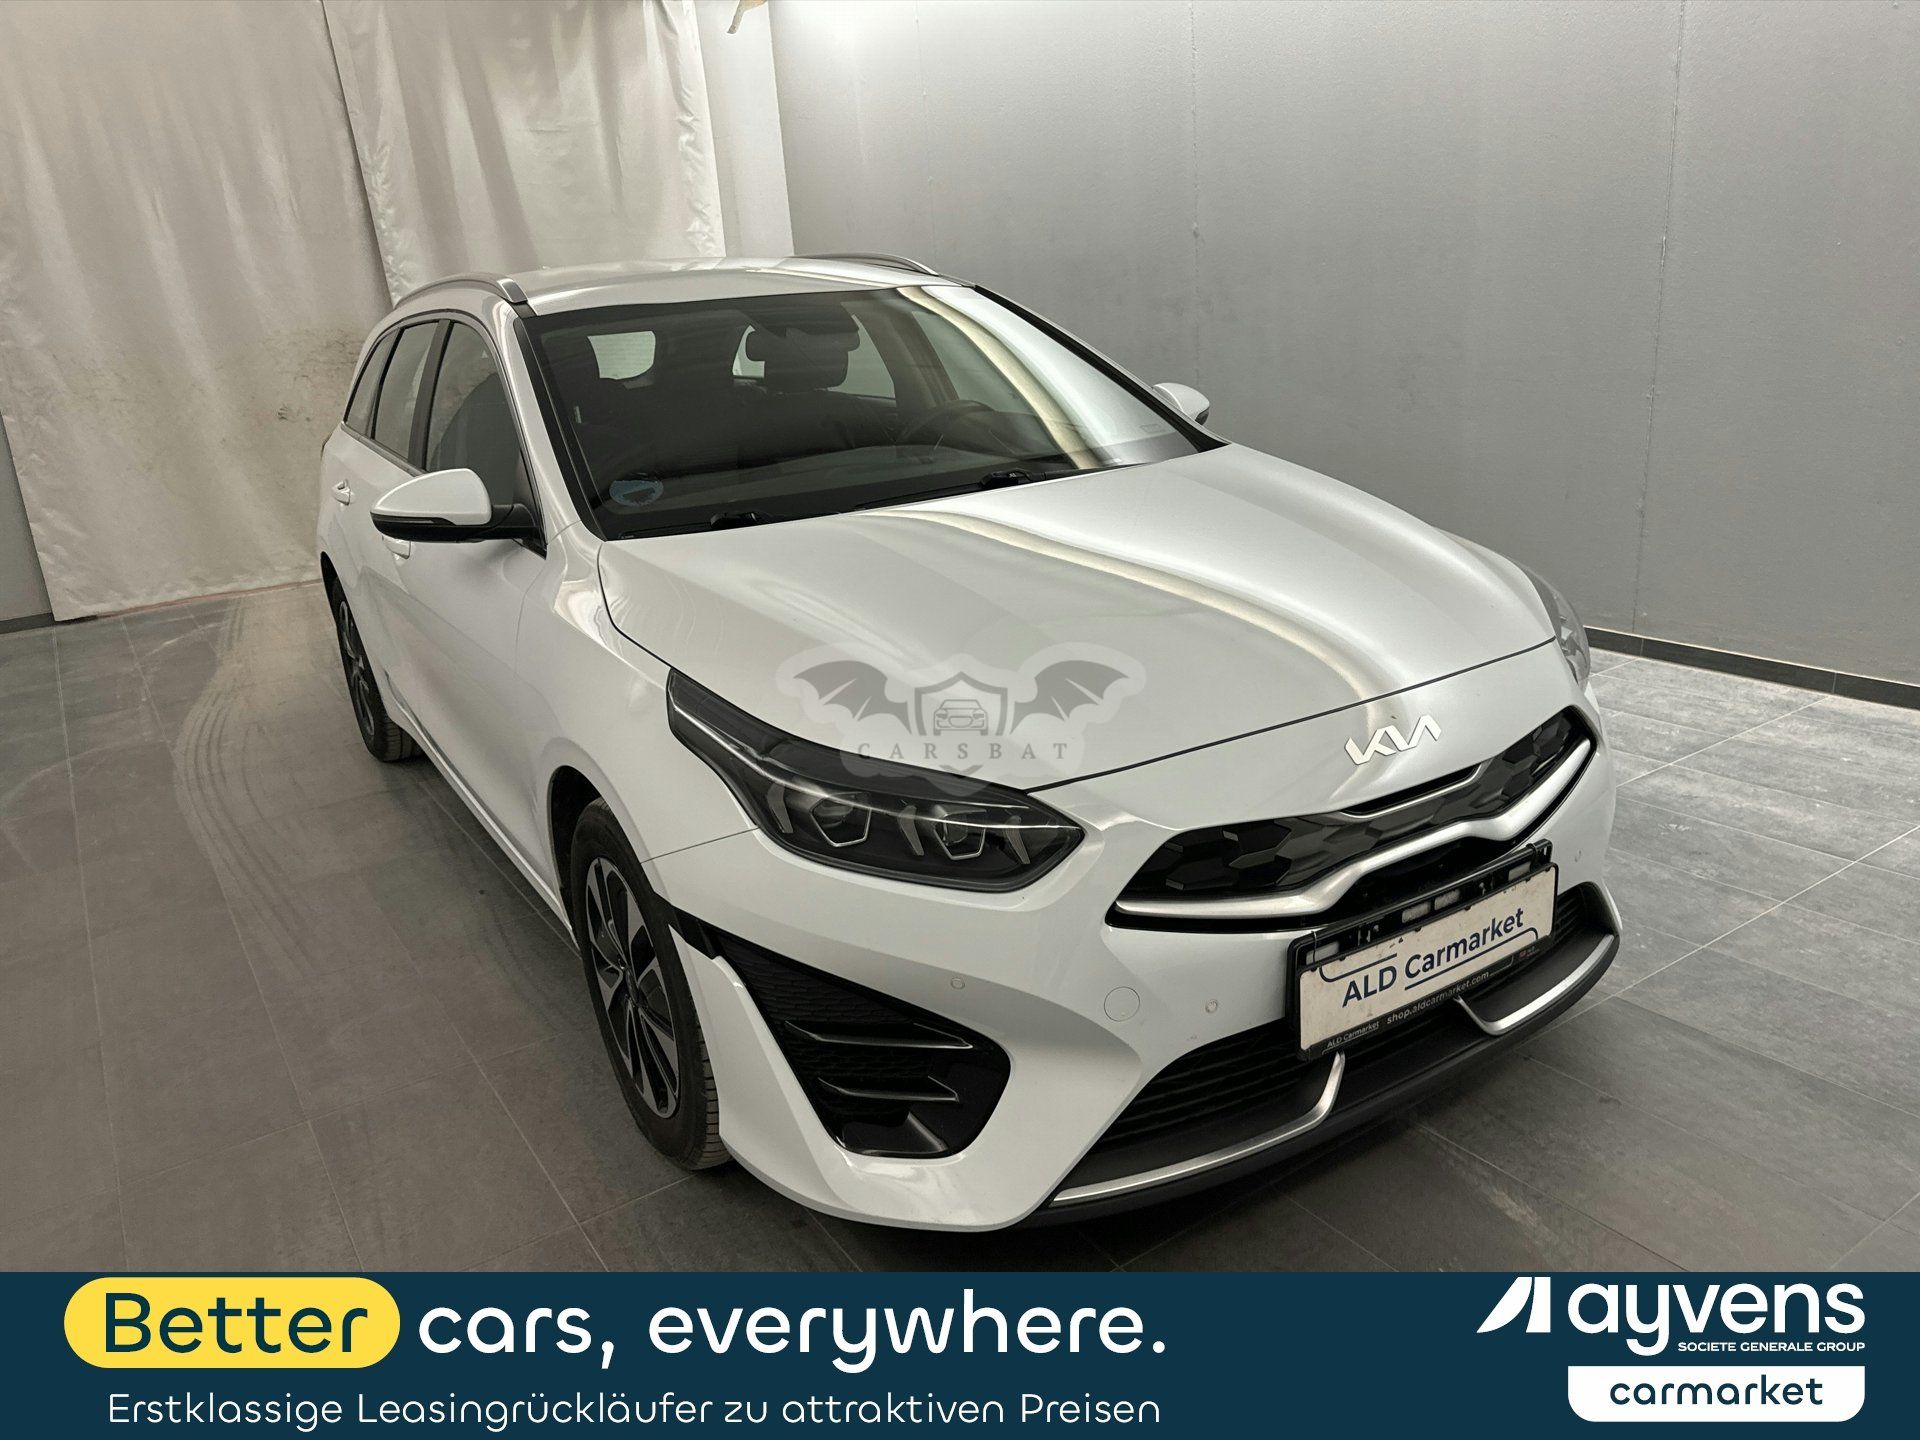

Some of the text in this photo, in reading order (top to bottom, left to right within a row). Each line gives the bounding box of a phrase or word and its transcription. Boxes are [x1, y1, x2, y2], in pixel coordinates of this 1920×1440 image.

[1342, 908, 1524, 1007] ALD Carmarket
[1387, 972, 1489, 1024] shop.aldcarmarket.com
[1327, 1021, 1380, 1048] ALD Carmarket
